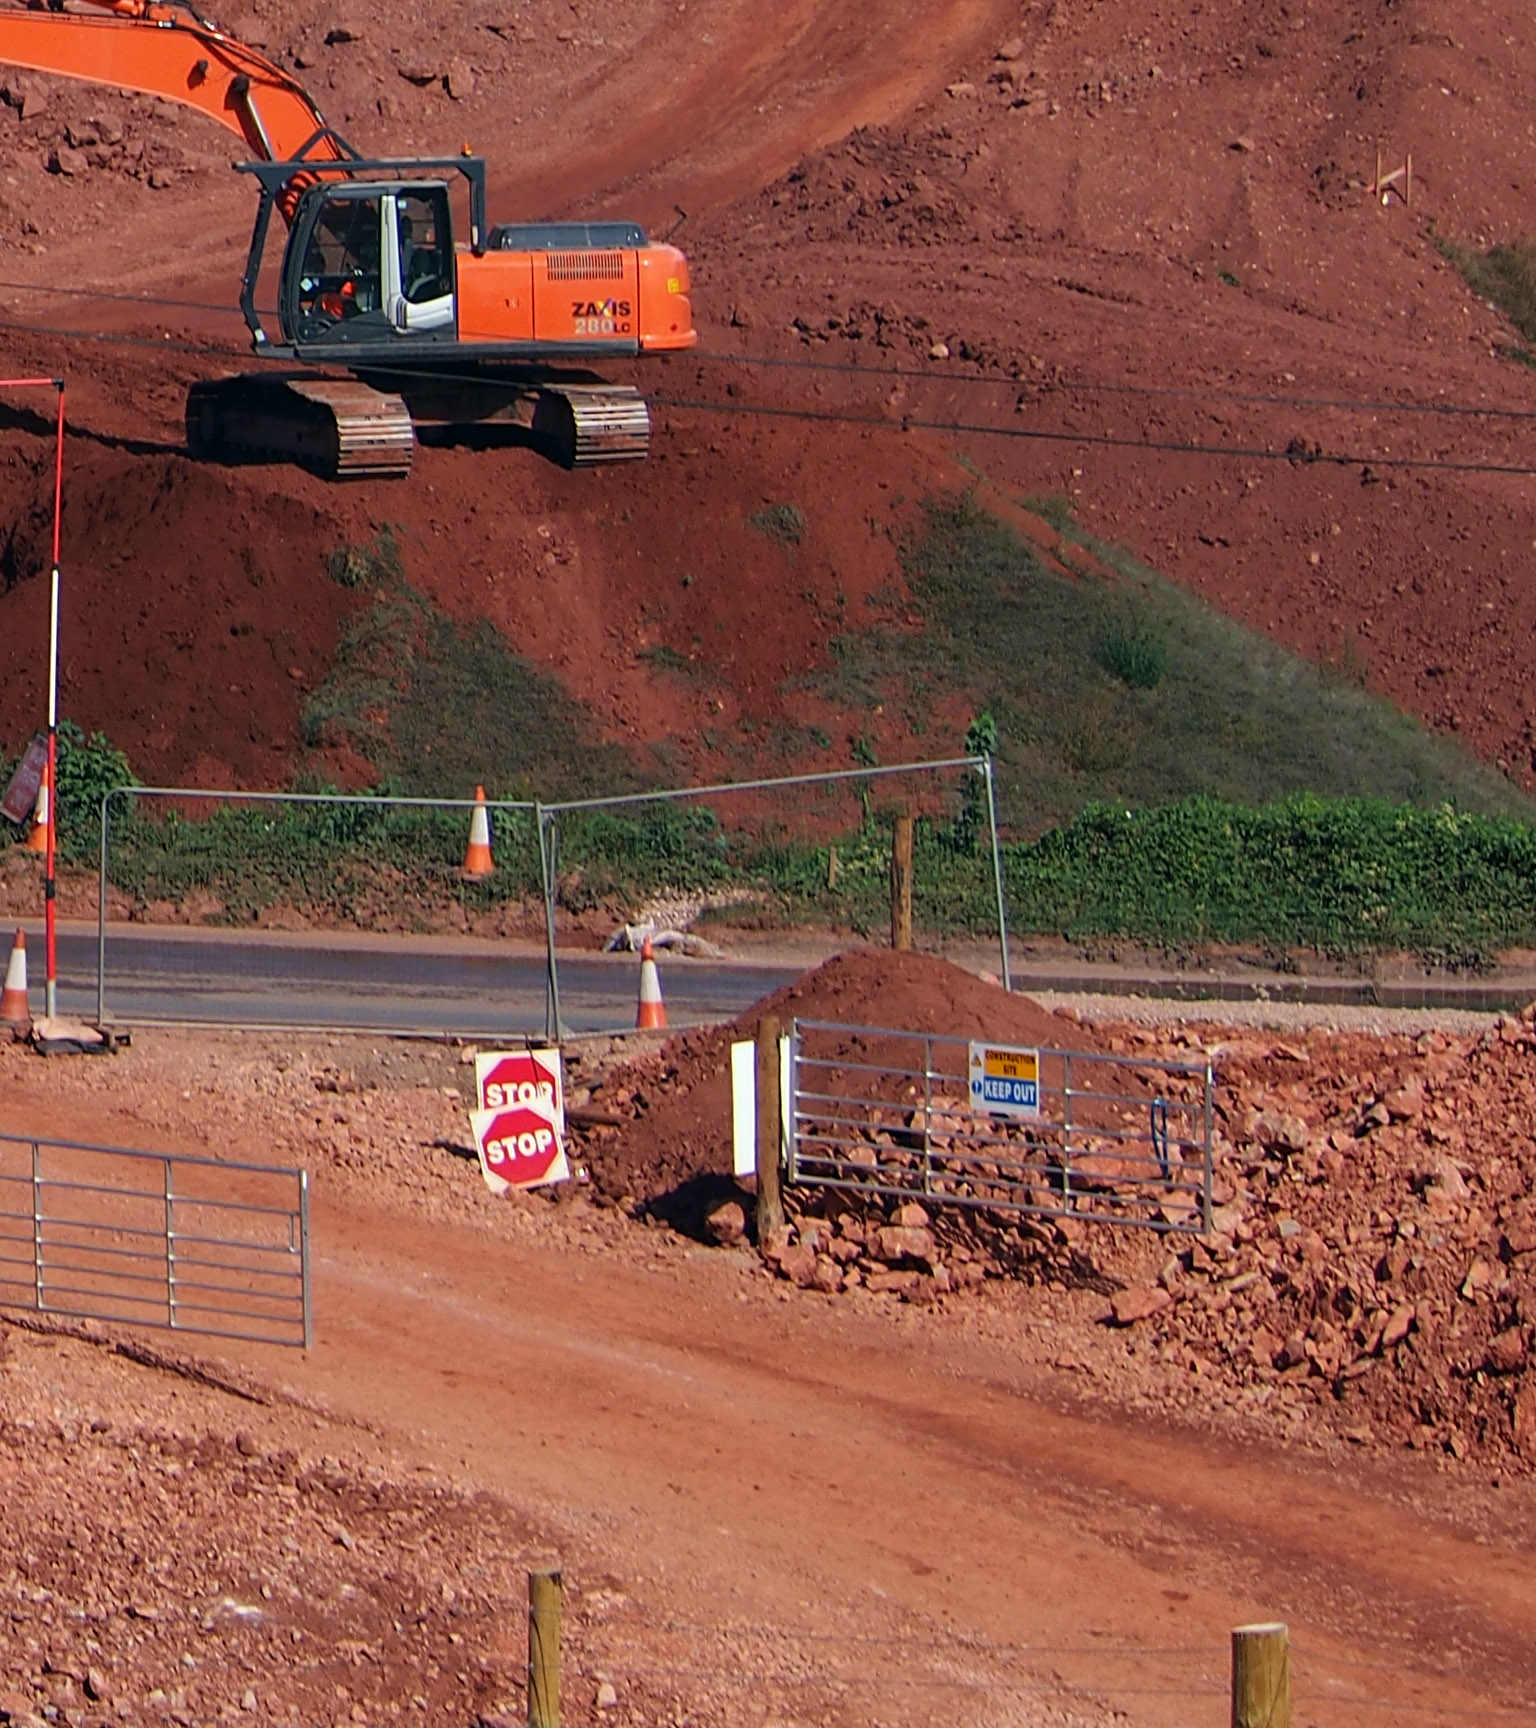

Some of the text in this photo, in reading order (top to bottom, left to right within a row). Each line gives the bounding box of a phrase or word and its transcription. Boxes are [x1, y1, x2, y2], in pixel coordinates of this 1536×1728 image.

[571, 298, 631, 317] ZAXIS
[574, 318, 631, 335] 280LC
[985, 1049, 1036, 1065] CONSTRUCTION
[984, 1079, 1035, 1103] KEEP OUT
[486, 1128, 553, 1165] STOP
